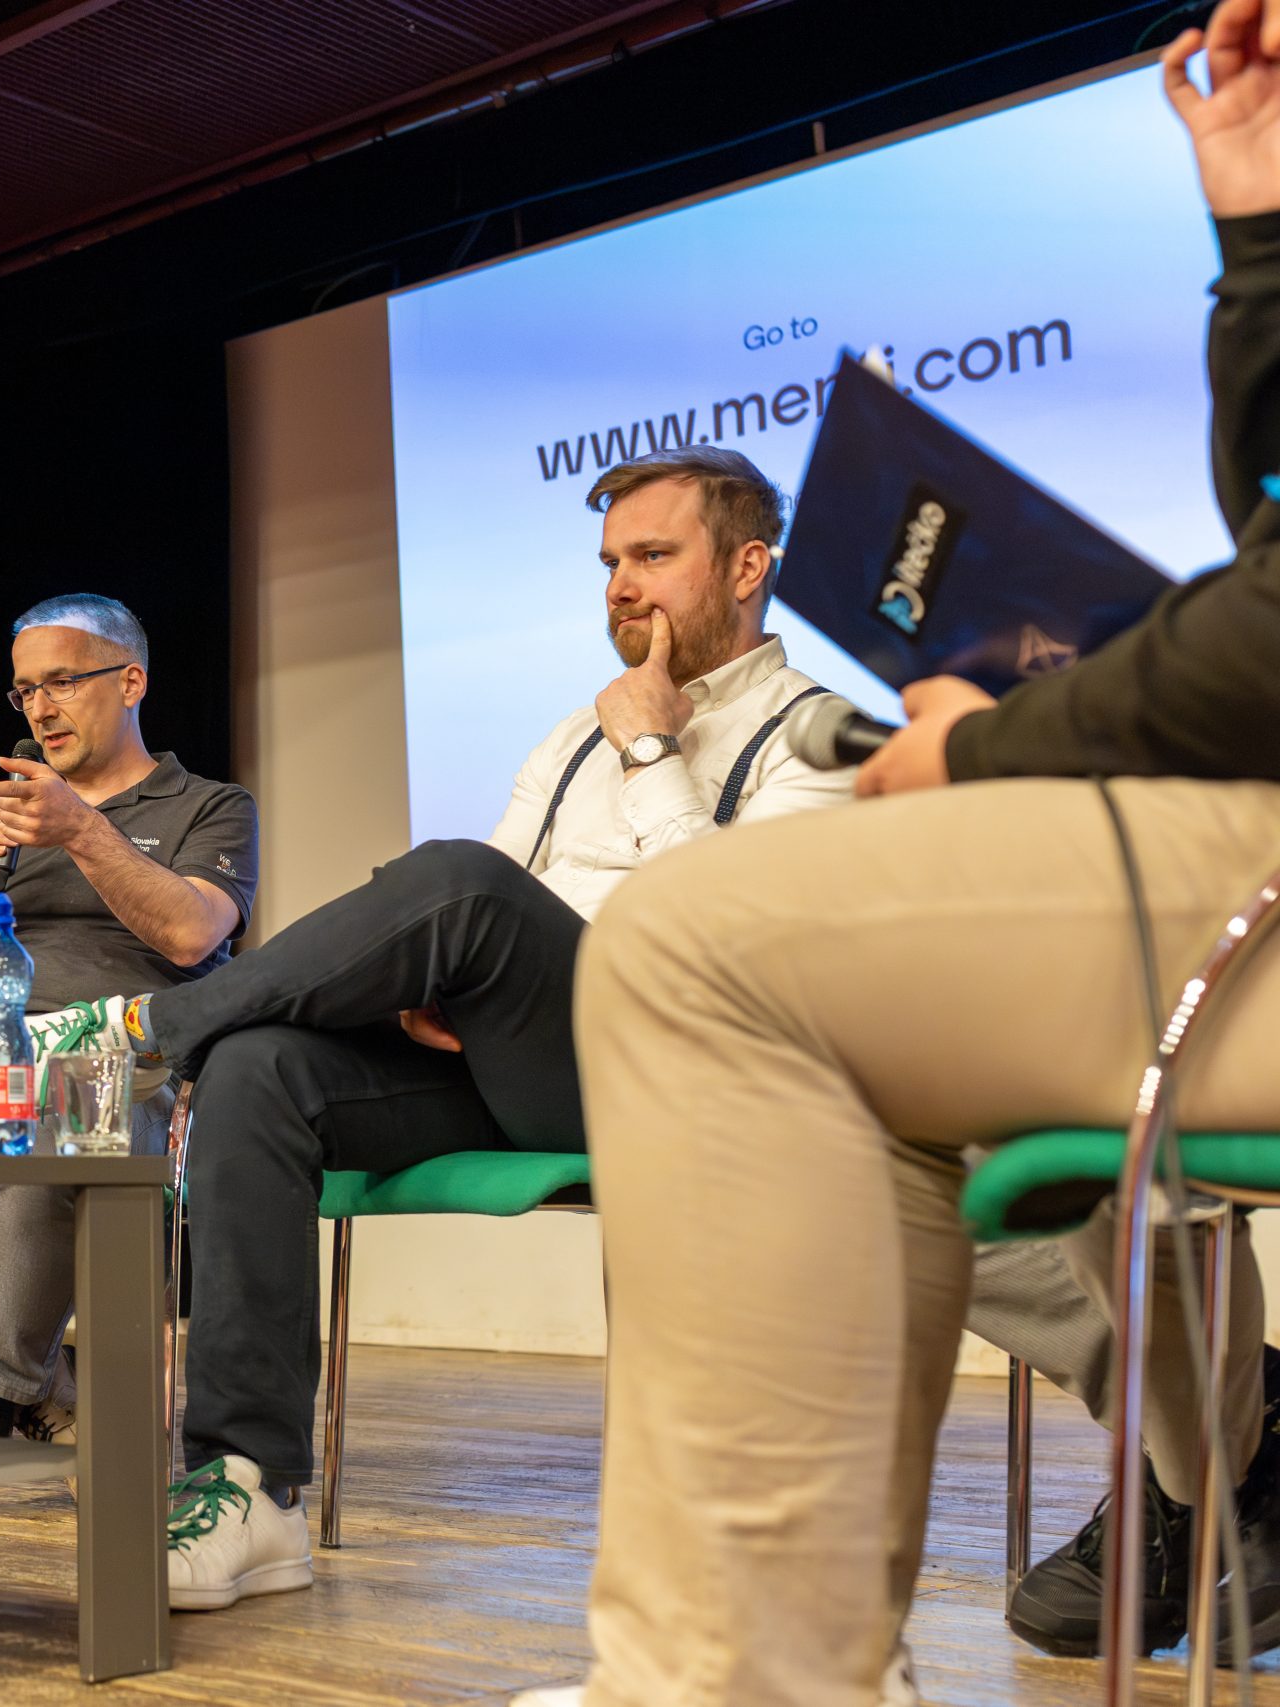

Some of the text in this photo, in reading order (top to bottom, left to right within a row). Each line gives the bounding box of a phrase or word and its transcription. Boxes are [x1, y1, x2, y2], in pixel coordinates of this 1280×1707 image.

[743, 316, 819, 351] Go to
[537, 318, 1073, 482] www.meni.com
